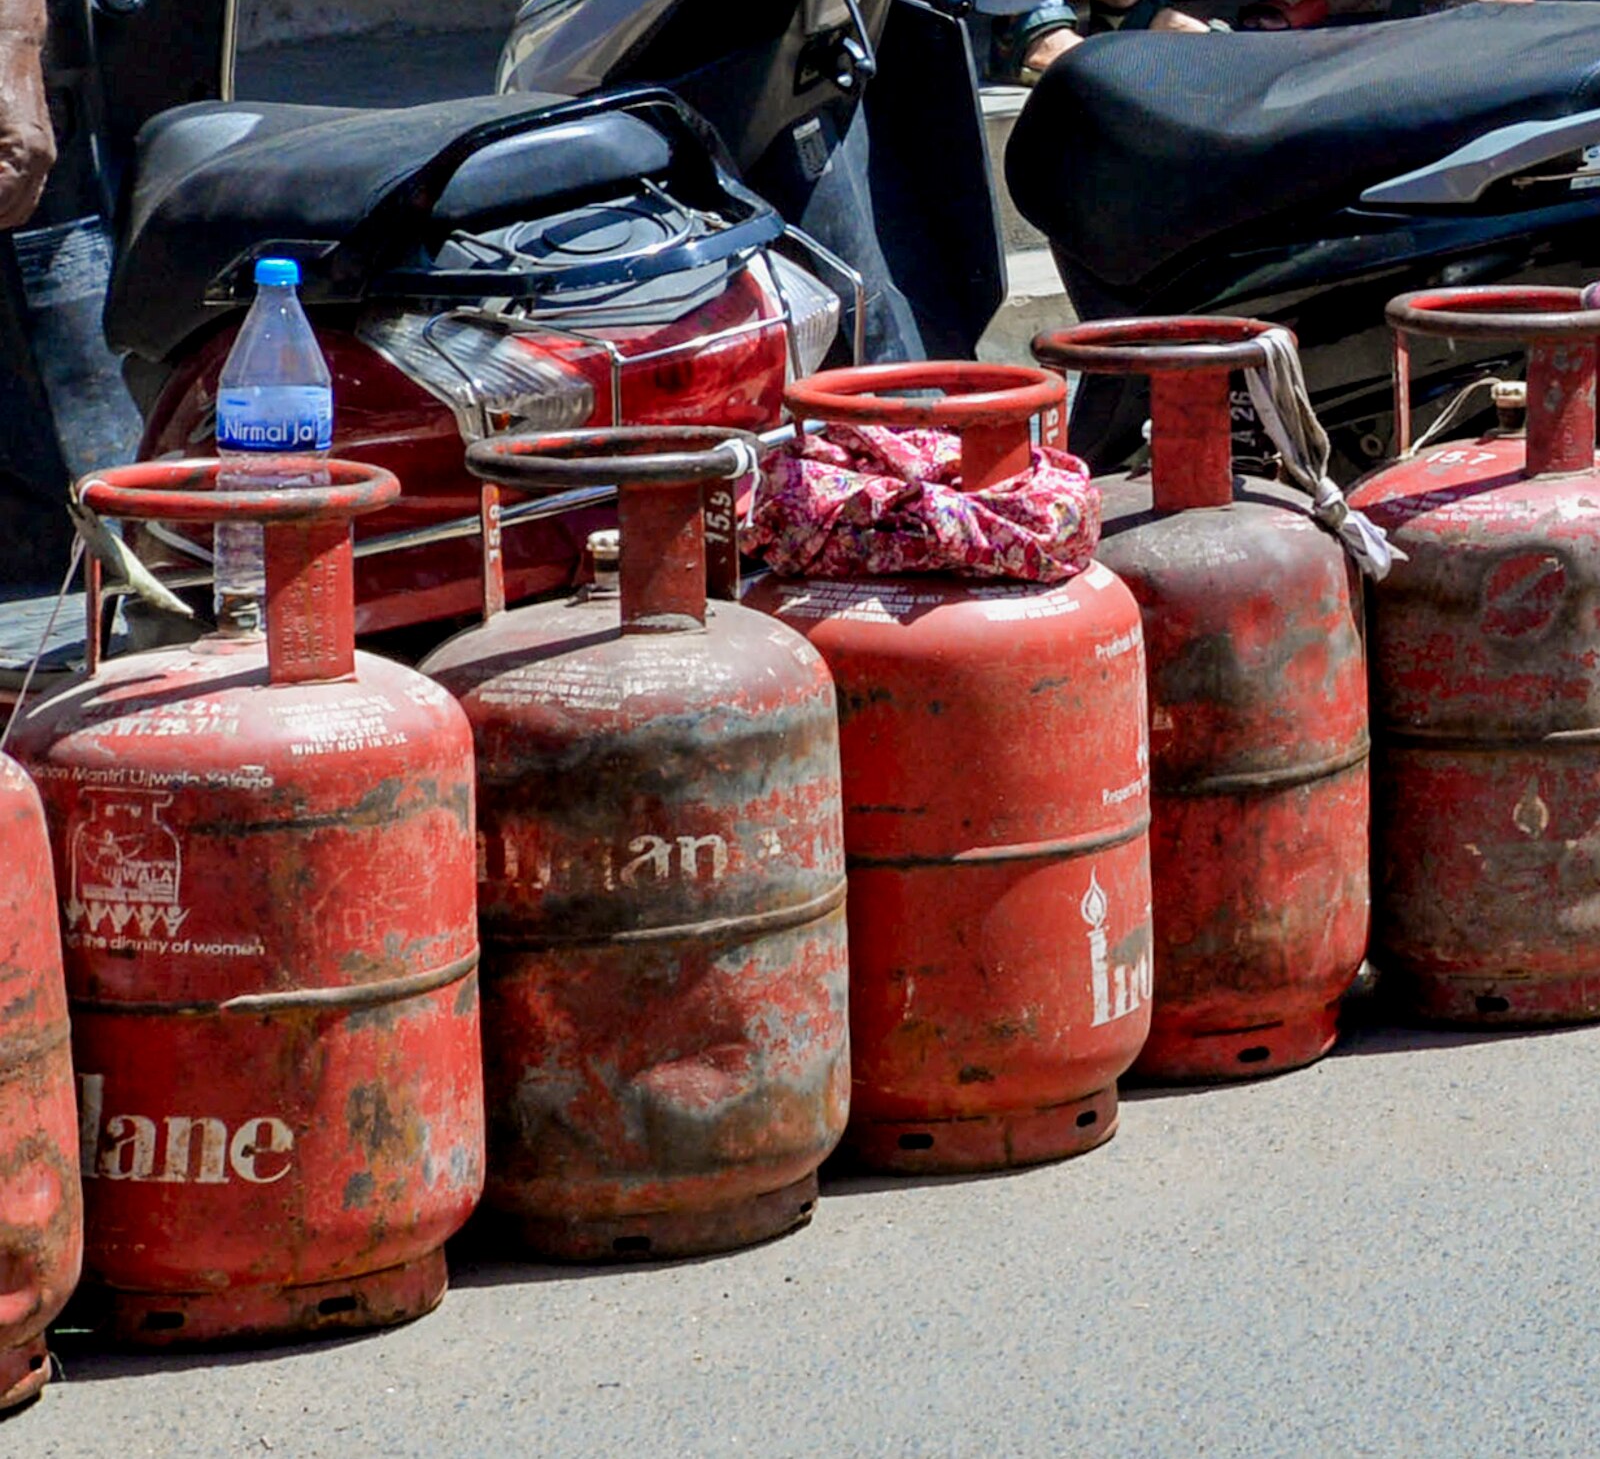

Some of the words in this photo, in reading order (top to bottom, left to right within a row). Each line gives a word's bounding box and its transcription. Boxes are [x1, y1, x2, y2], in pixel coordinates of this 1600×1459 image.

[224, 417, 288, 442] Nirmal
[1426, 450, 1498, 465] 15.7
[338, 738, 365, 754] NOT
[368, 735, 382, 749] IN
[73, 766, 125, 784] Mantri
[171, 938, 190, 954] of
